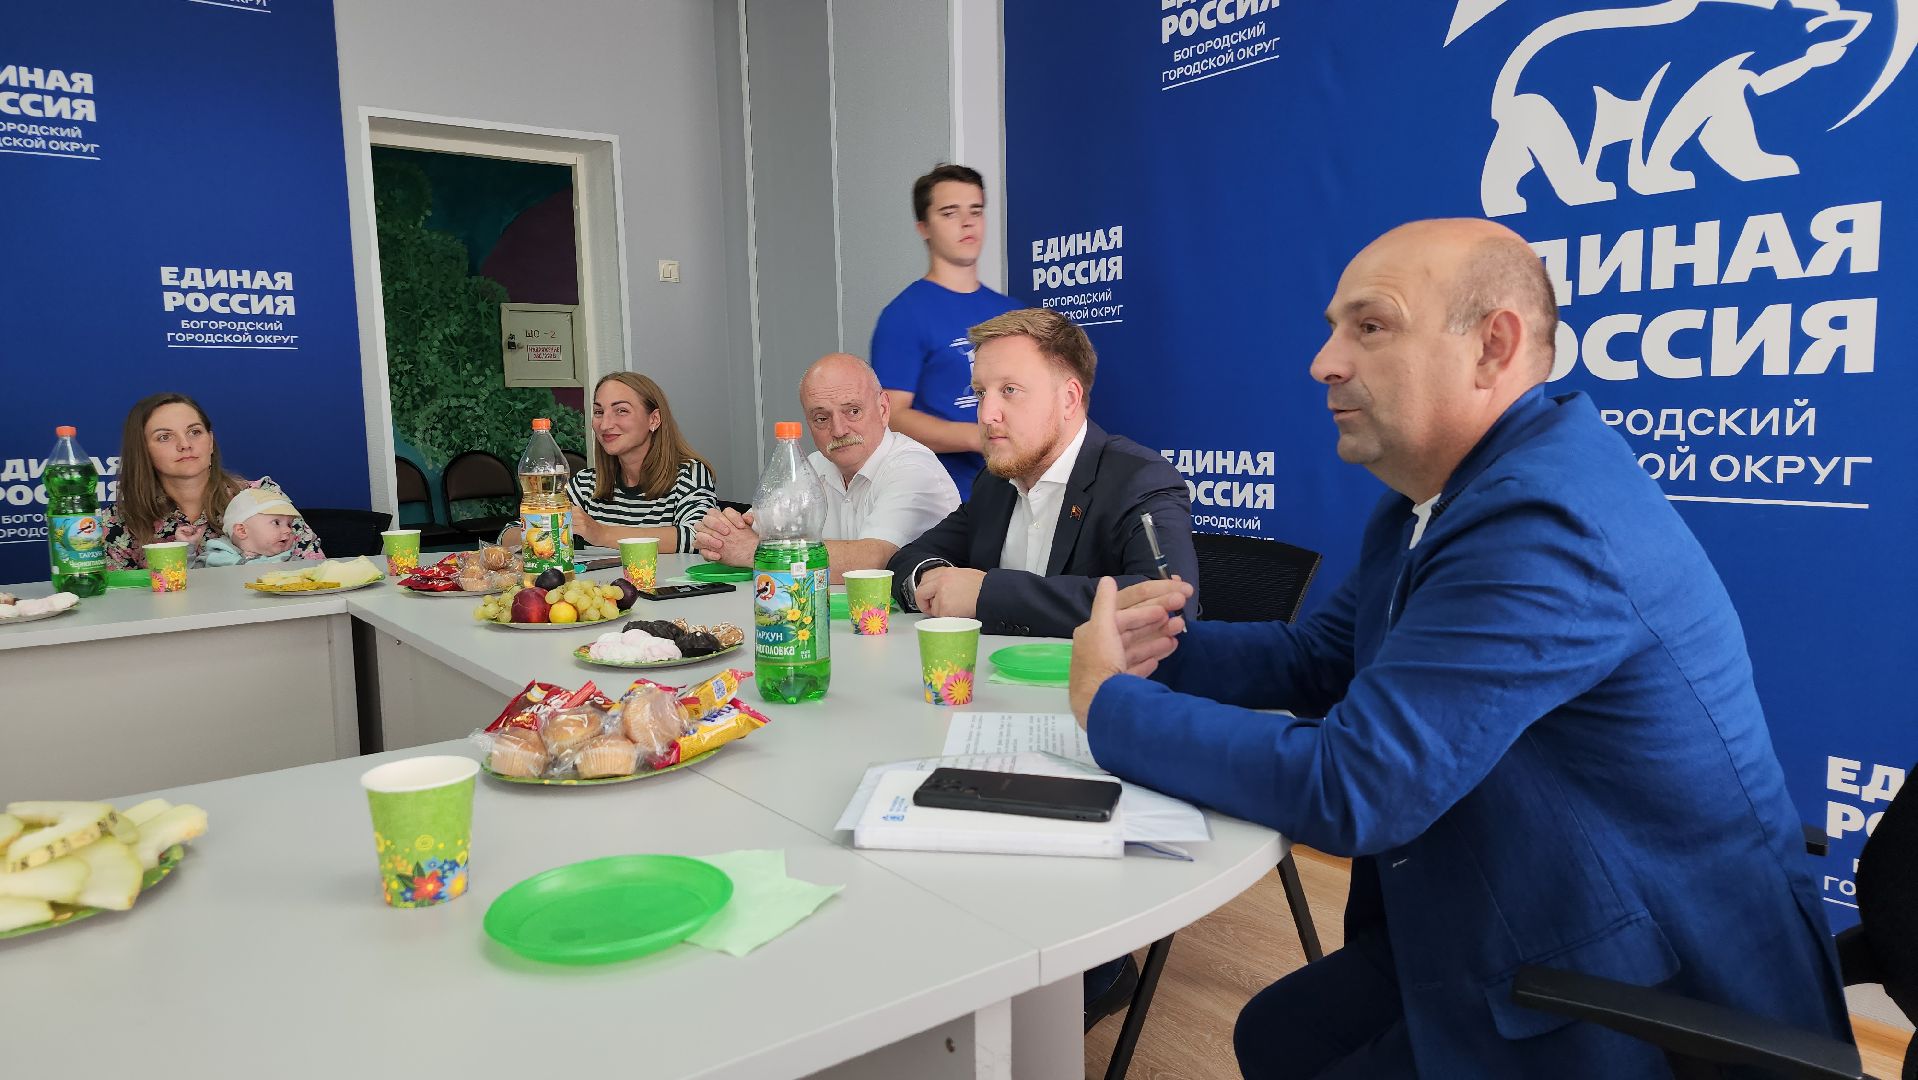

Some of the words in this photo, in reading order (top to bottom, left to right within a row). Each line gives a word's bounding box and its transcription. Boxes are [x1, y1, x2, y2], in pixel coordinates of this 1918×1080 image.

[1174, 21, 1265, 62] БОГОРОДСКИЙ
[1162, 50, 1234, 82] ГОРОДСКОЙ
[1237, 37, 1280, 60] ОКРУГ
[0, 136, 46, 149] СКОЙ
[48, 139, 100, 153] ОКРУГ
[1032, 225, 1123, 264] ЕДИНАЯ
[160, 266, 293, 290] ЕДИНАЯ
[1032, 255, 1123, 291] РОССИЯ
[163, 291, 296, 316] РОССИЯ
[1042, 288, 1112, 308] БОГОРОДСКИЙ
[1091, 304, 1124, 318] ОКРУГ
[181, 319, 283, 331] БОГОРОДСКИЙ
[167, 332, 252, 343] ГОРОДСКОЙ
[254, 334, 299, 344] ОКРУГ
[1709, 453, 1873, 486] ОКРУГ
[1191, 514, 1261, 531] ОРОДСКИЙ
